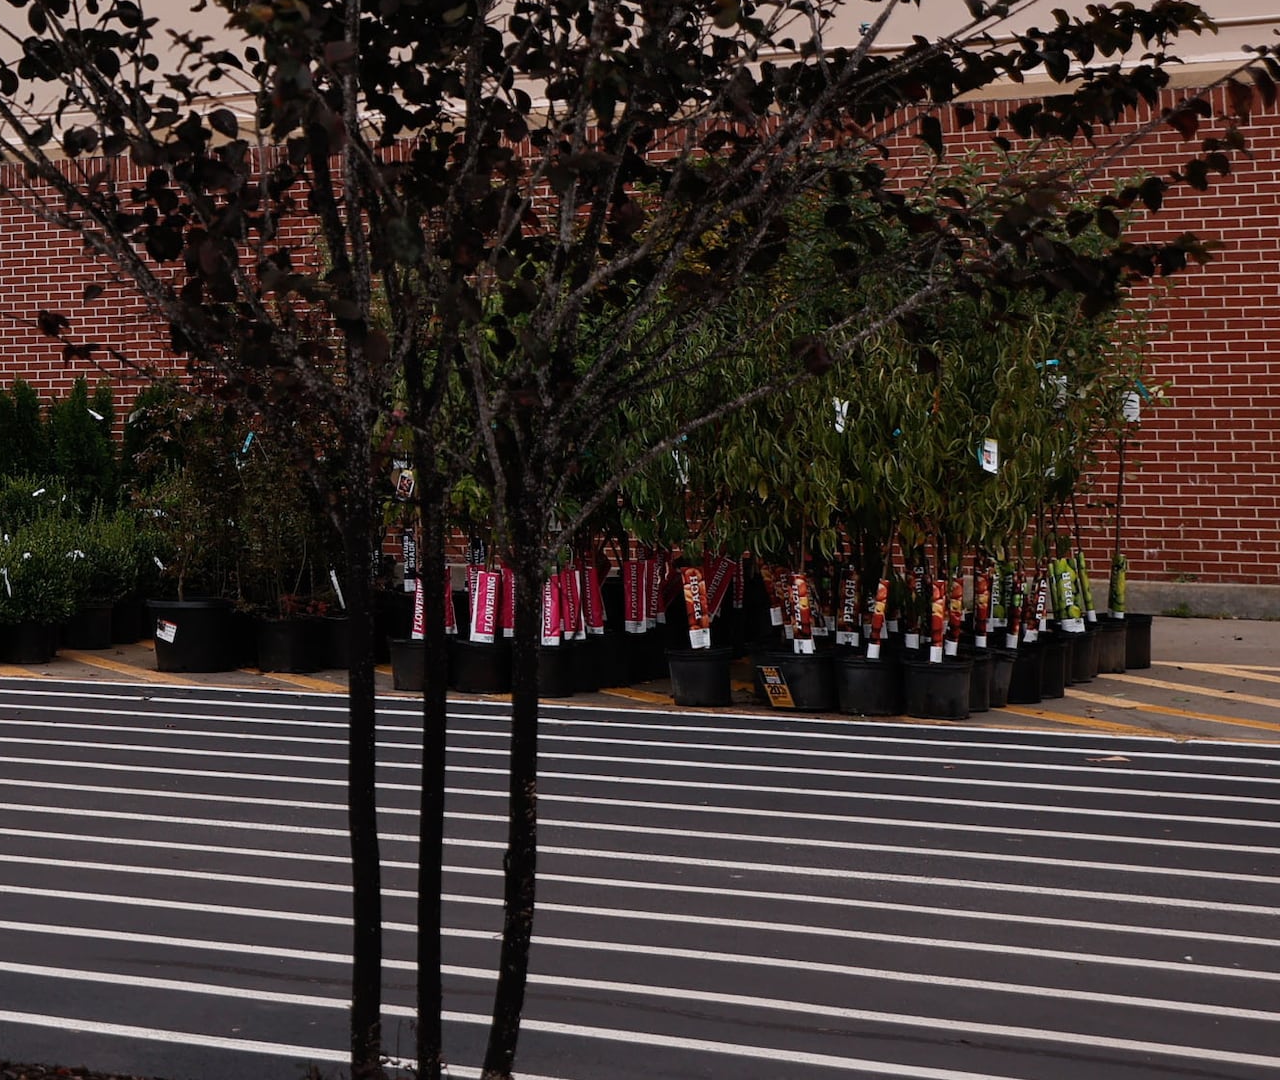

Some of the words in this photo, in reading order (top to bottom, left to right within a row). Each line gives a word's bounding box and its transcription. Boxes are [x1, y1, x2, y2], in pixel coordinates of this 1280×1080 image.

[565, 573, 577, 629] FLOWERING
[689, 576, 702, 620] PEACH
[706, 560, 729, 600] OWERING
[843, 579, 857, 623] PEACH
[1062, 571, 1074, 606] PEAR
[484, 576, 496, 633] FLOWERING
[792, 583, 802, 630] PEACH
